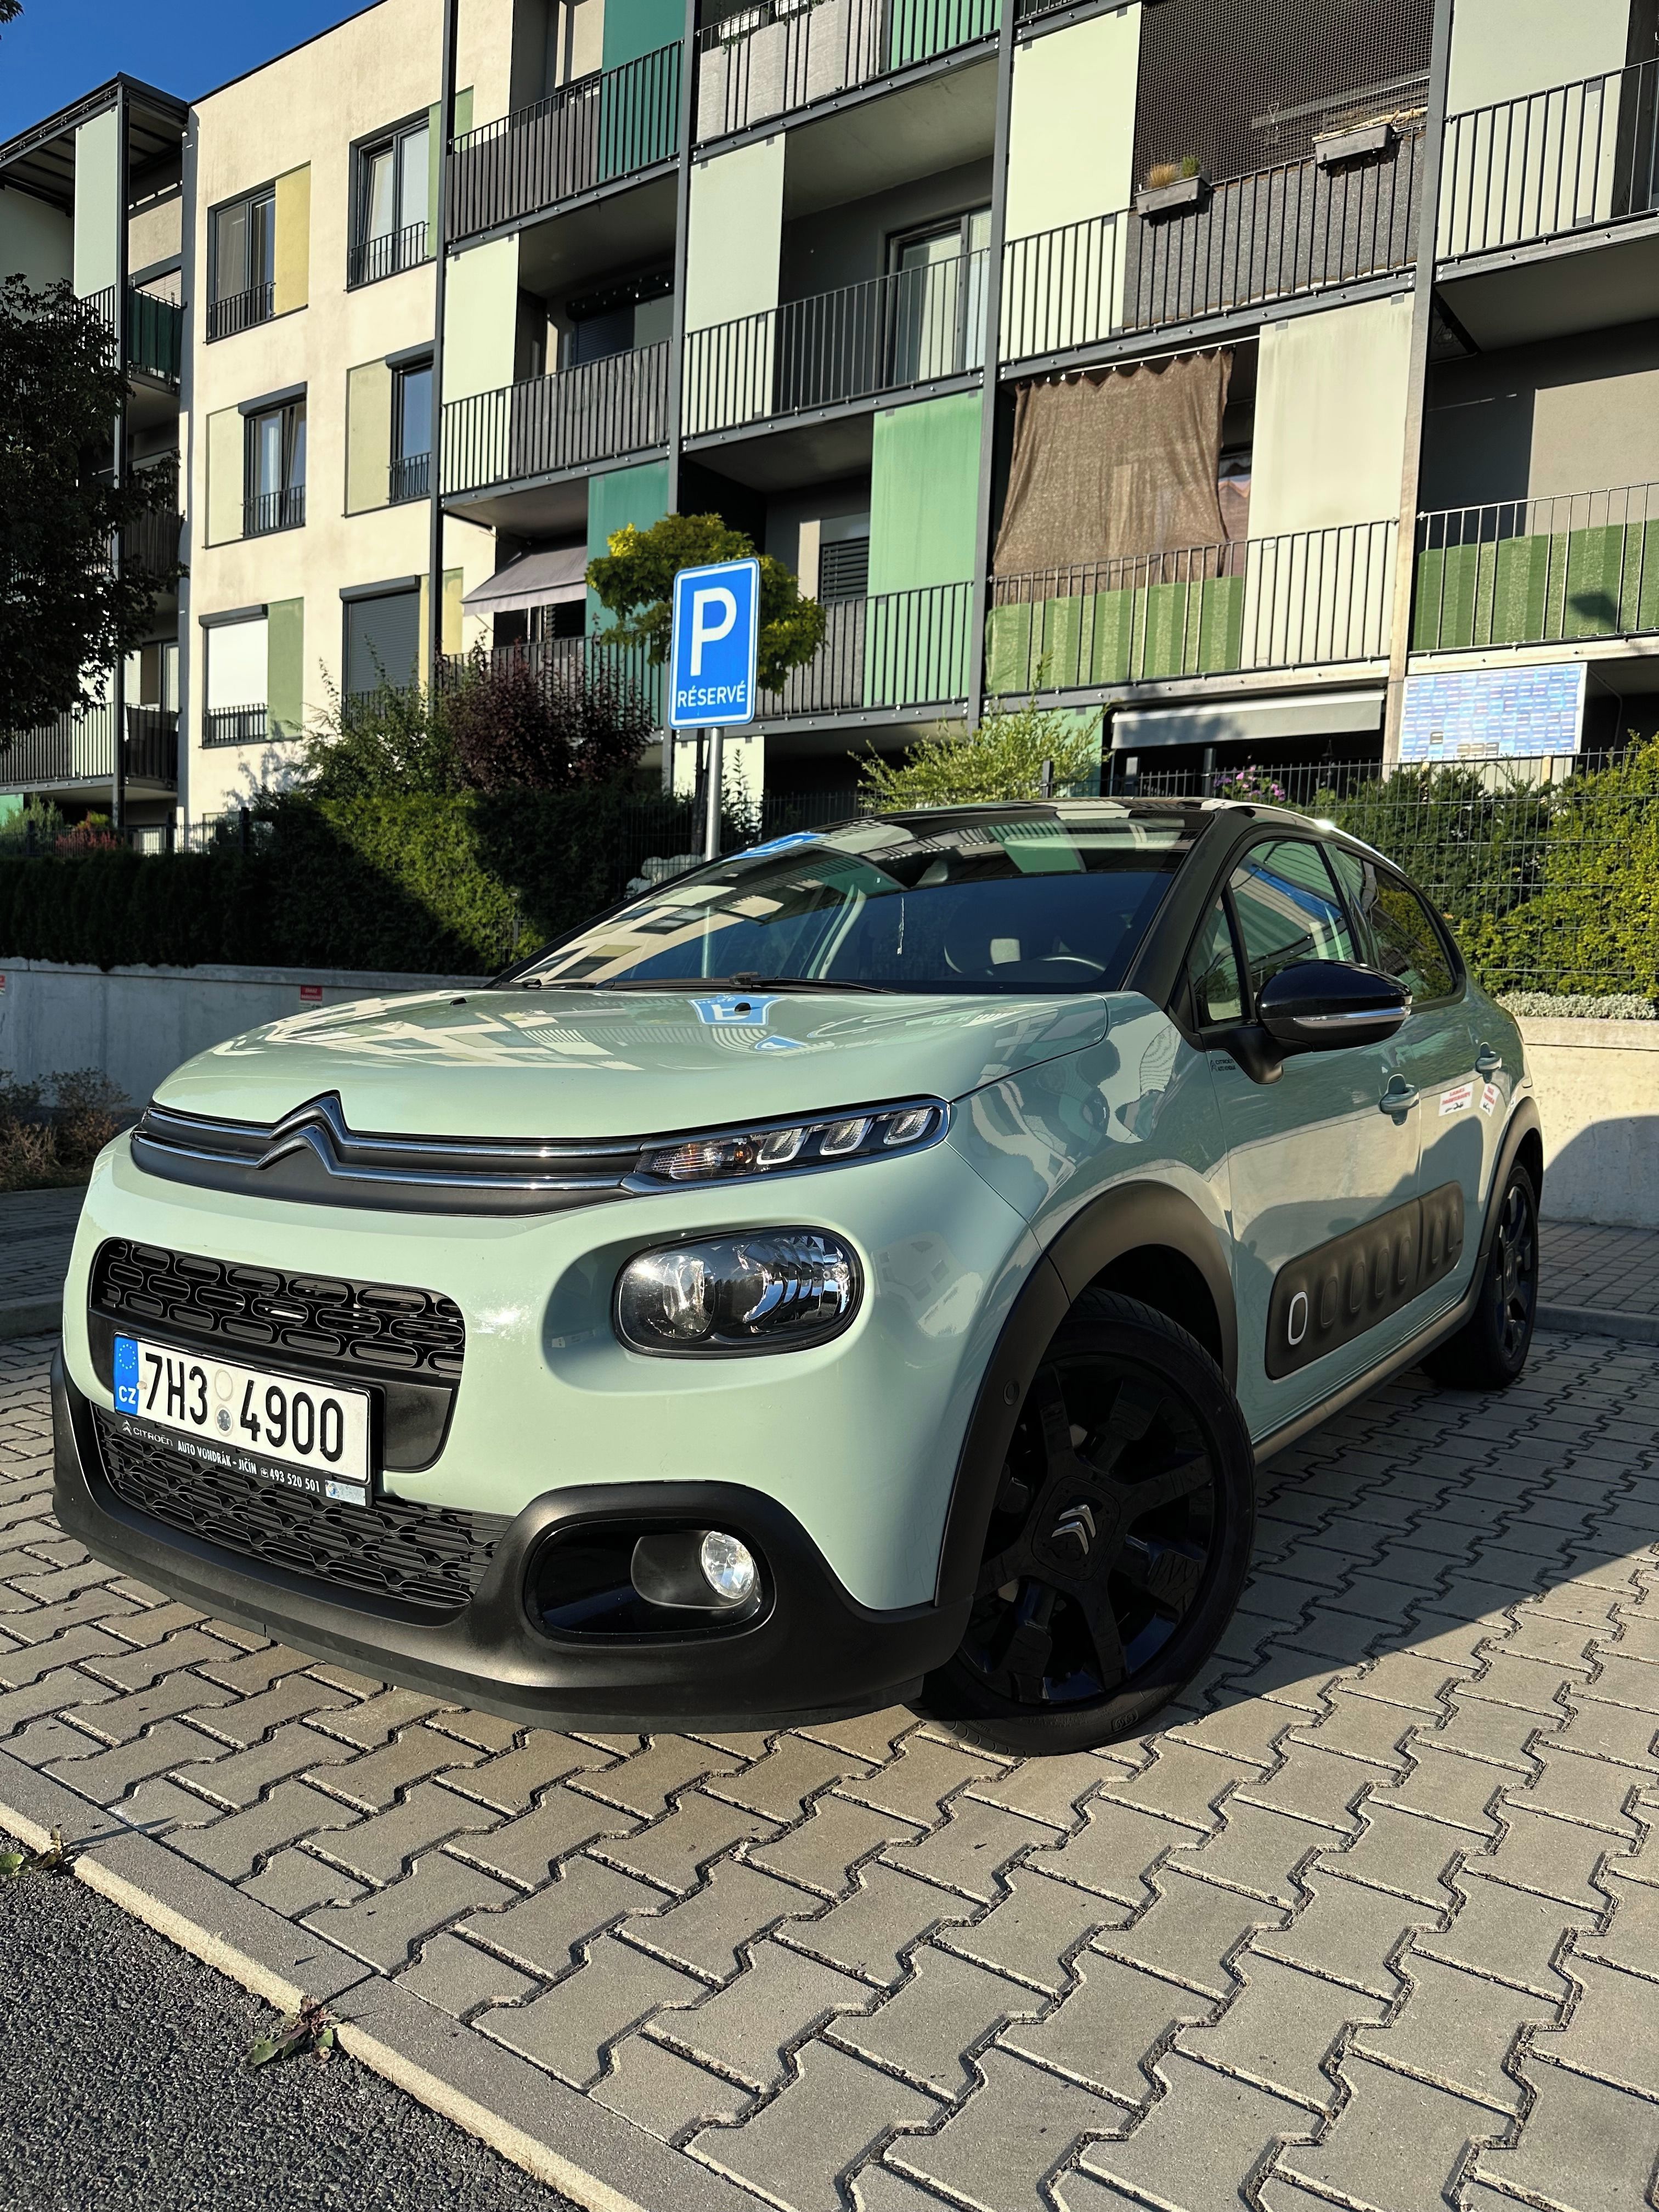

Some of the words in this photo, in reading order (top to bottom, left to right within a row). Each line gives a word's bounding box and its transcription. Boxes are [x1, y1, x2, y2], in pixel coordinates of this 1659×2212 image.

[690, 587, 737, 676] P
[678, 680, 746, 708] RÉSERVÉ
[119, 1386, 136, 1405] CZ
[145, 1352, 207, 1425] 7H3
[240, 1380, 343, 1462] 4900
[178, 1440, 195, 1455] AUTO
[196, 1446, 232, 1467] VONDRÁK
[239, 1458, 257, 1475] JIČÍN
[270, 1468, 285, 1482] 493
[287, 1473, 302, 1488] 520
[305, 1478, 320, 1493] 501
